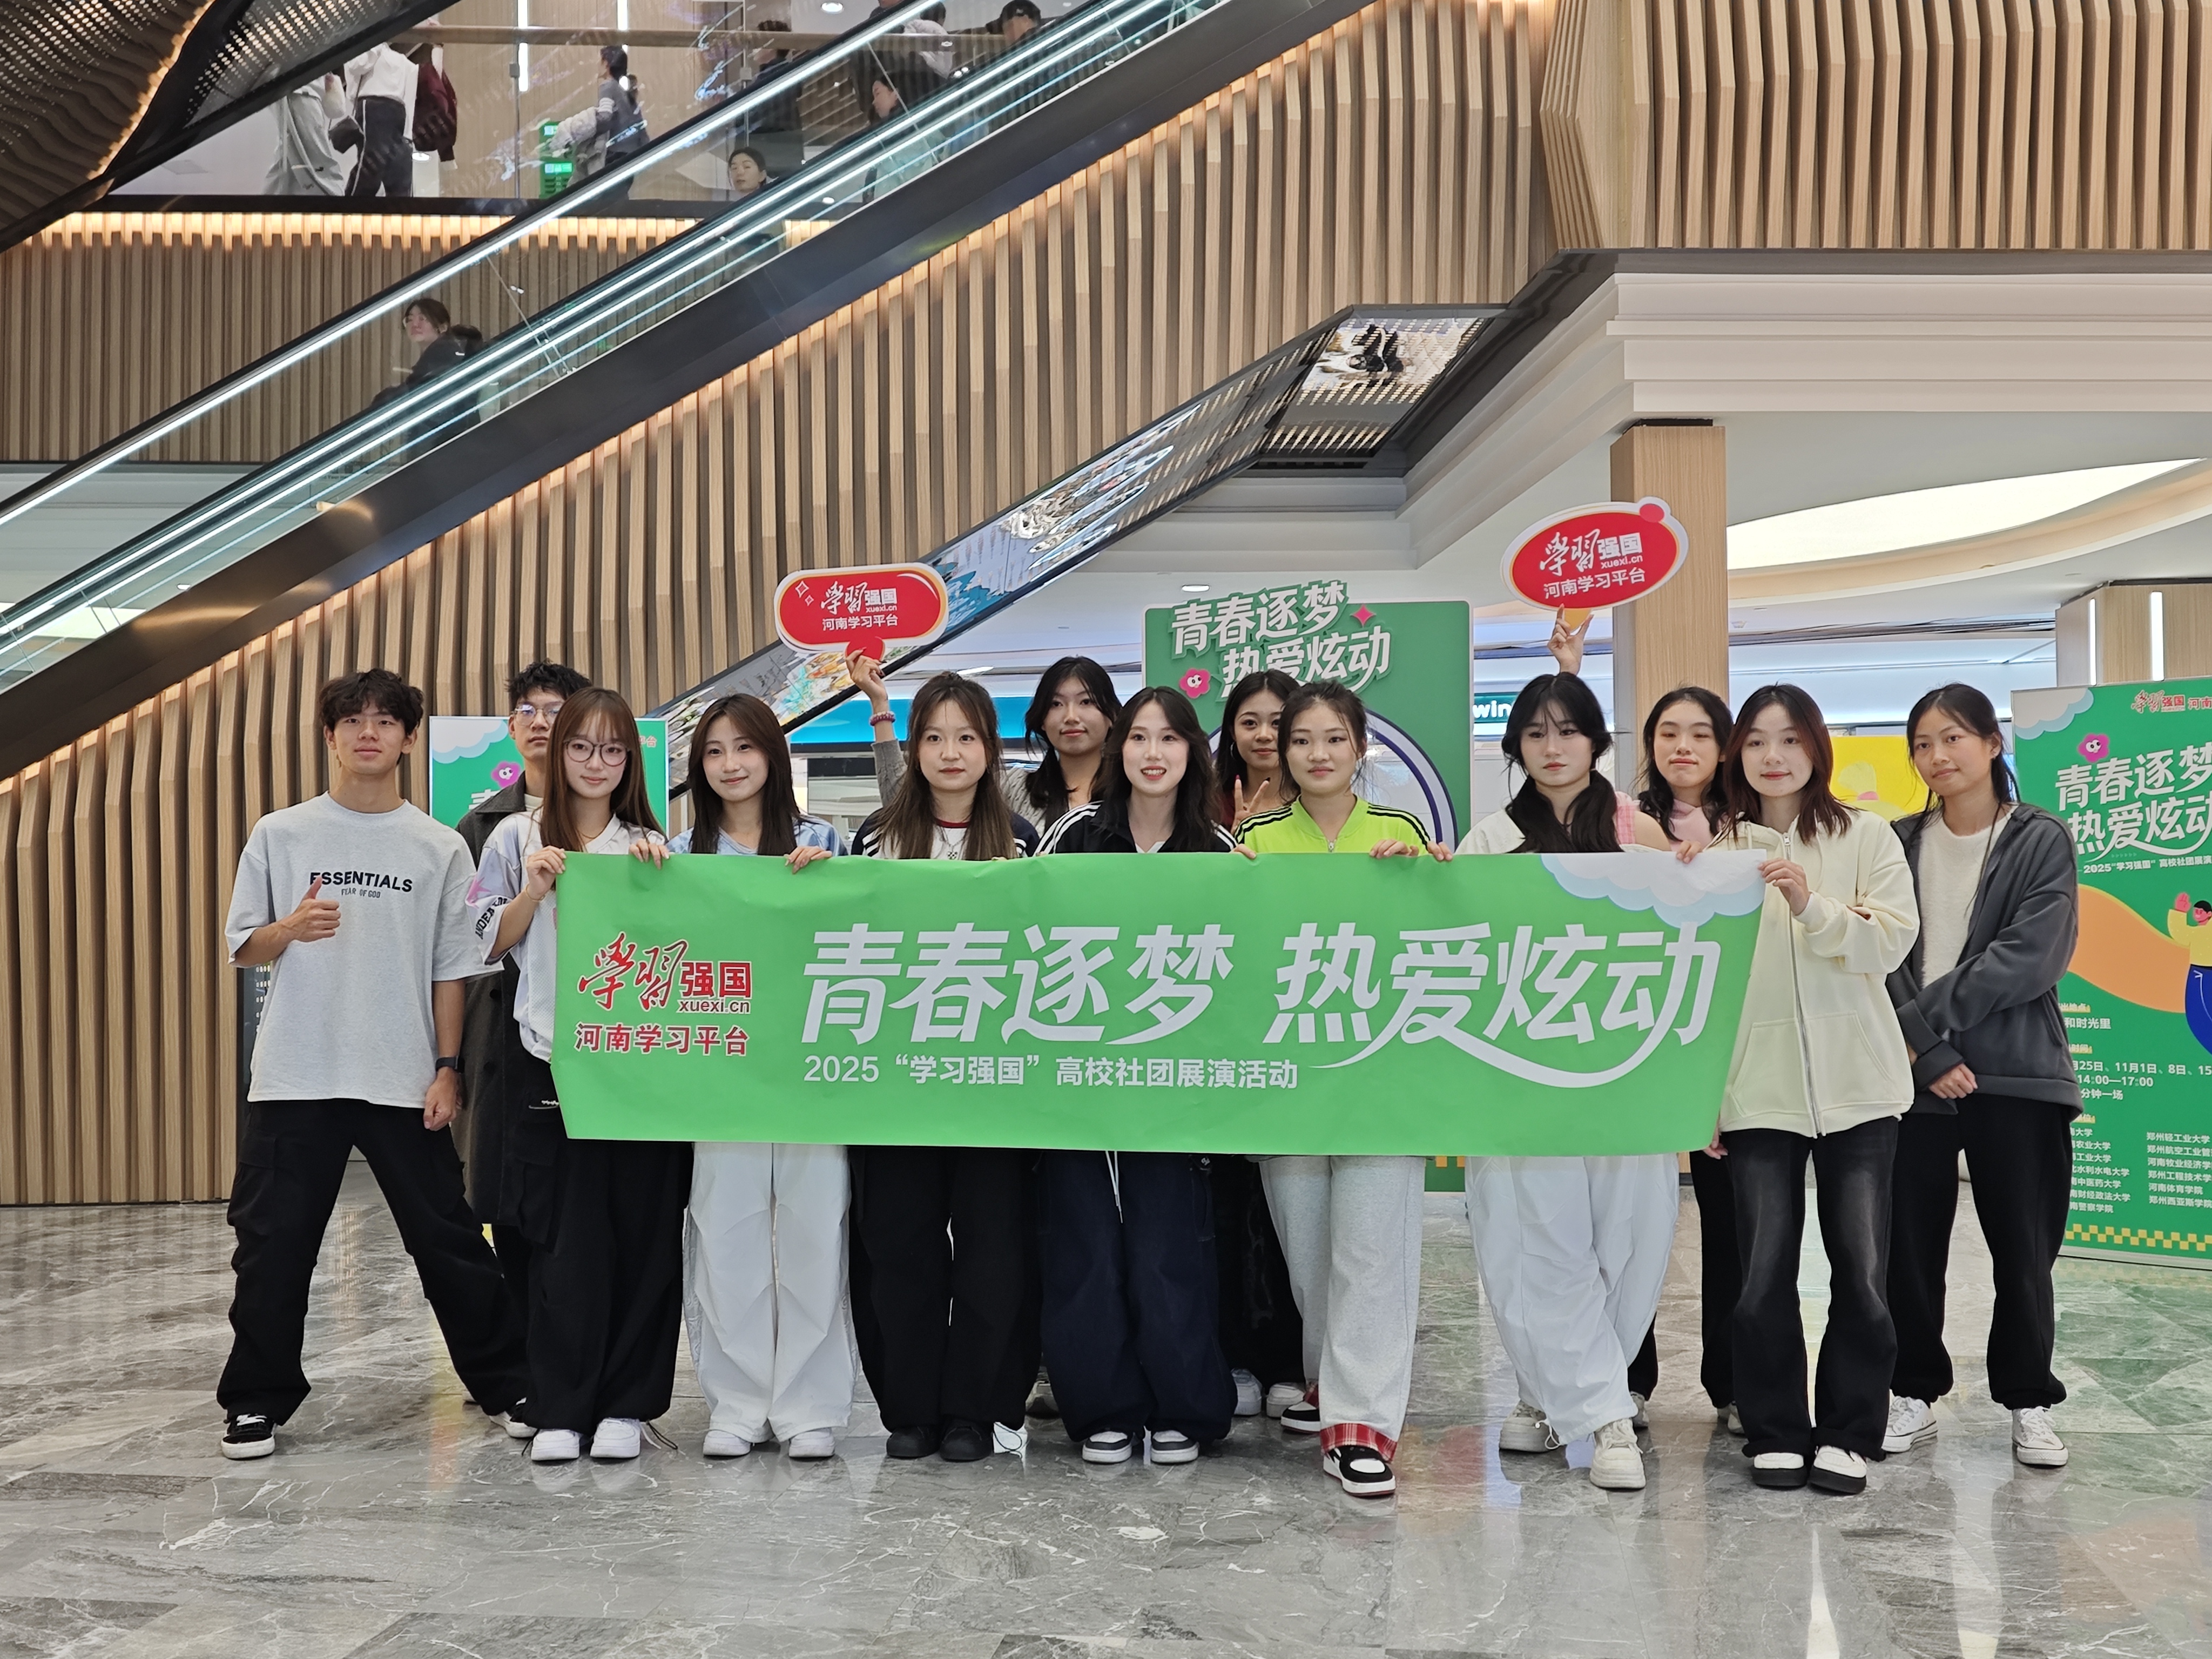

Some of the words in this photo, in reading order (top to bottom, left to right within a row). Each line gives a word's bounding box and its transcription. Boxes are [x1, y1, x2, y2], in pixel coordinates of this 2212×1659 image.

[1601, 555, 1643, 569] xuexi.cn
[1543, 567, 1645, 599] 河南学习平台
[866, 604, 897, 613] xuexi.cn
[822, 614, 898, 631] 河南学习平台
[1171, 580, 1346, 655] 青春逐梦
[1472, 700, 1515, 718] win
[2055, 741, 2212, 811] 青春逐梦
[310, 871, 413, 892] ESSENTIALS
[341, 887, 356, 896] FEAR
[359, 889, 367, 897] OF
[368, 890, 381, 898] GOD
[677, 999, 751, 1014] xuexi.cn
[801, 922, 1235, 1046] 青春逐梦
[1262, 921, 1722, 1089] 热爱炫动
[574, 1021, 750, 1056] 河南学习平台
[803, 1055, 879, 1082] 2025
[895, 1053, 1040, 1085] “学习强国”
[1056, 1056, 1298, 1090] 高校社团展演活动
[2146, 1132, 2210, 1144] 郑州轻工业大学
[2147, 1144, 2212, 1157] 郑州航空工业管
[2148, 1157, 2212, 1170] 河南牧业经济学
[2149, 1183, 2203, 1195] 河南体育学院
[2149, 1195, 2212, 1209] 郑州西亚斯学院
